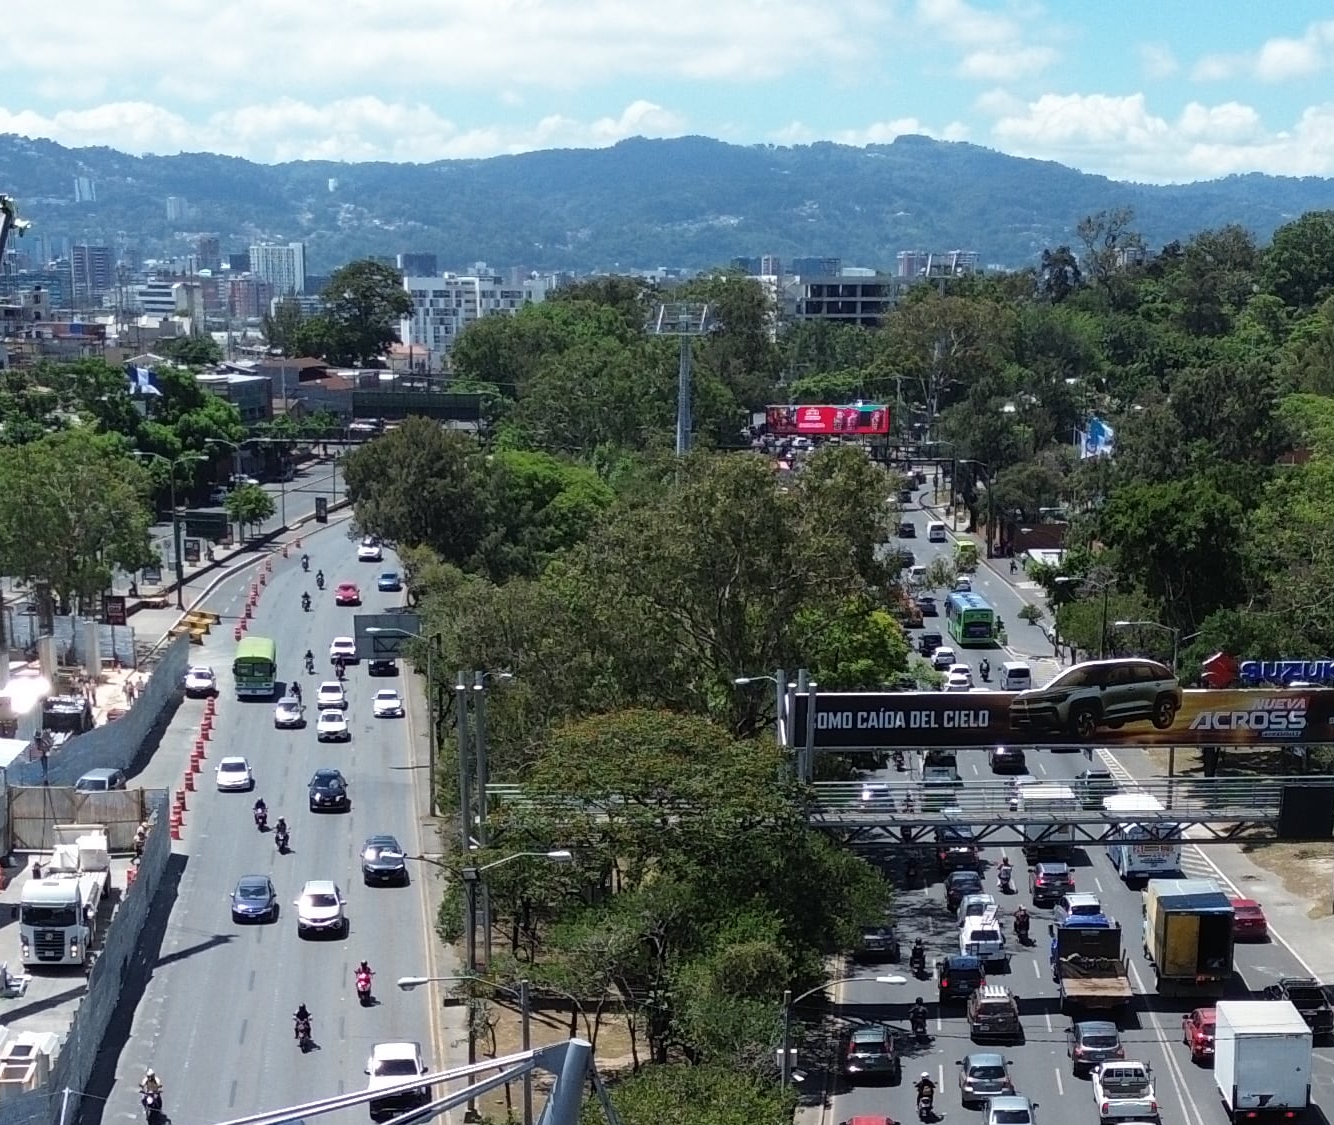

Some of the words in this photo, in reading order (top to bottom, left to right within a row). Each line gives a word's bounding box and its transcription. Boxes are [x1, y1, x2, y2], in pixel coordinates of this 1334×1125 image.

[1253, 698, 1307, 710] NUEVA
[814, 711, 853, 730] OMO
[856, 707, 906, 729] CAÍDA
[909, 710, 939, 729] DEL
[943, 709, 990, 728] CIELO
[1187, 710, 1308, 730] ACROSS
